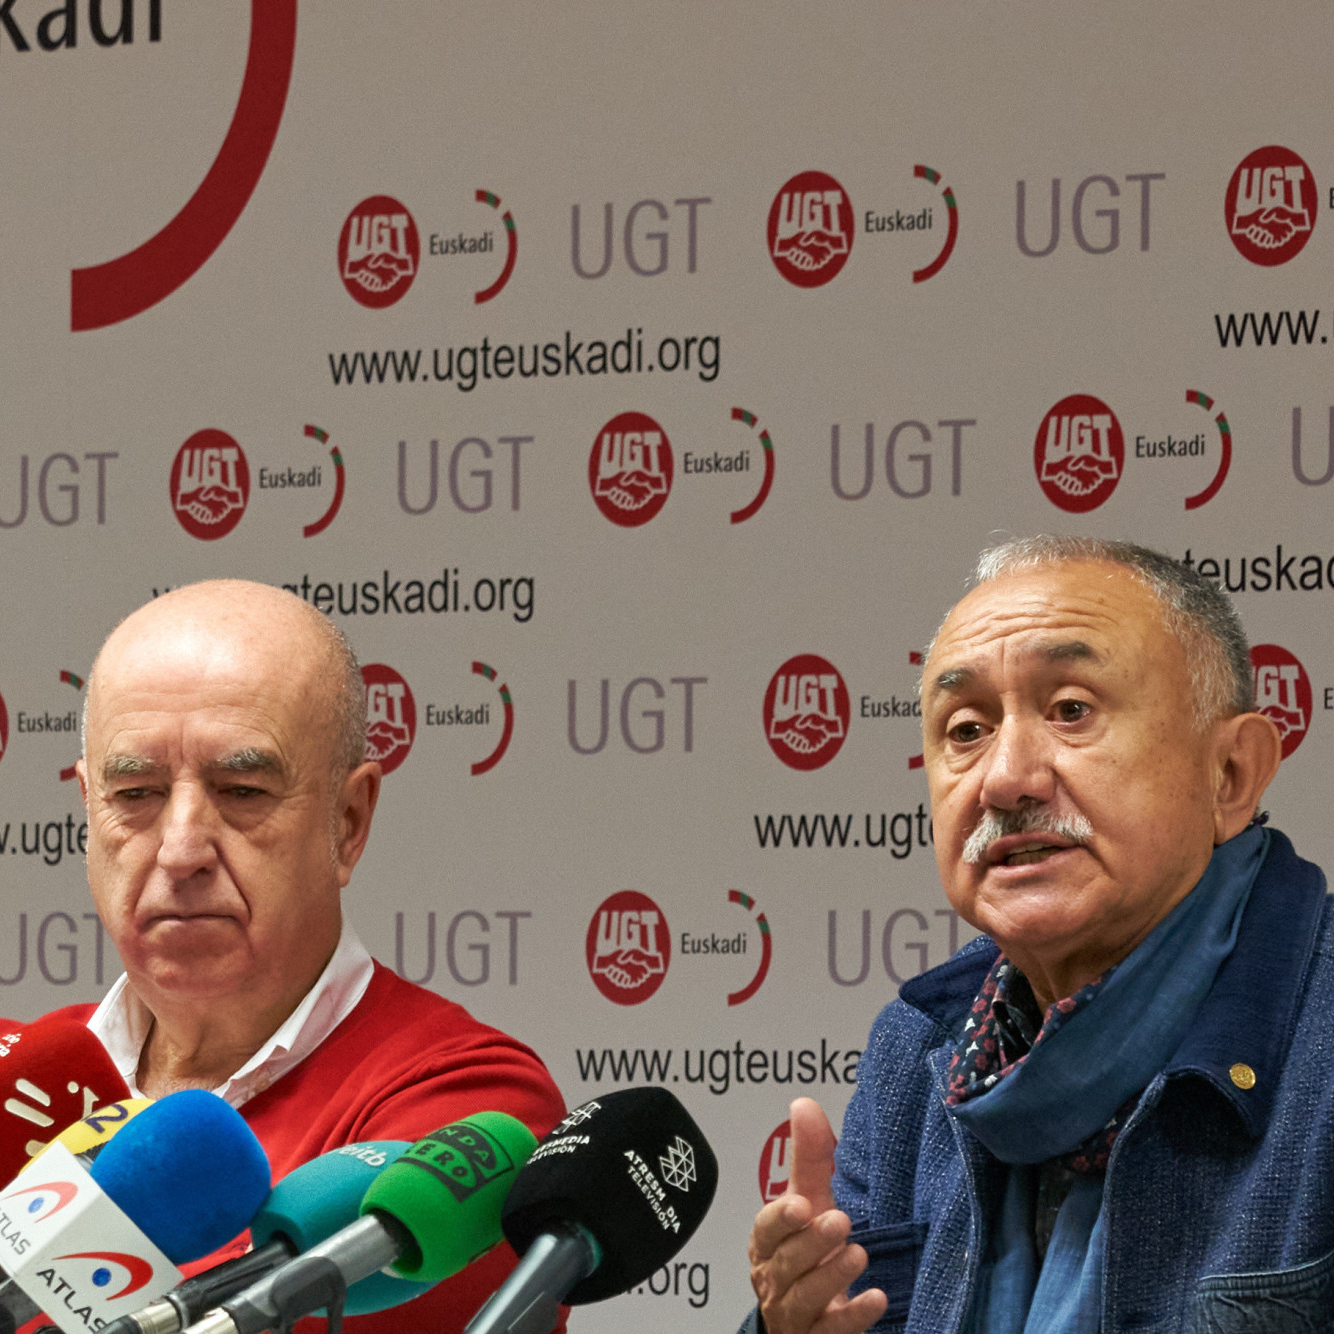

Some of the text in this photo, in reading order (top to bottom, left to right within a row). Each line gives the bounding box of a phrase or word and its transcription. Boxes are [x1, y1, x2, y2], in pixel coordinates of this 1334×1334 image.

[1239, 165, 1306, 210] UGT
[349, 213, 494, 257] UGT Euskadi
[783, 190, 934, 234] UGT Euskadi
[1014, 172, 1166, 259] UGT
[570, 196, 712, 281] UGT
[328, 328, 722, 392] www.ugteuskadi.org
[602, 430, 751, 476] UGT Euskadi
[829, 418, 977, 501] UGT
[1046, 414, 1206, 460] UGT Euskadi
[183, 446, 322, 492] UGT Euskadi
[396, 435, 535, 516] UGT
[365, 682, 490, 727] GT Euskadi
[773, 674, 838, 717] UGT
[1254, 664, 1300, 713] GT
[17, 711, 78, 734] Euskadi
[566, 676, 708, 756] UGT
[393, 910, 533, 988] UGT
[596, 909, 747, 957] UGT Euskadi
[406, 1142, 469, 1178] ERO
[438, 1126, 491, 1164] NDA
[35, 1267, 109, 1334] ATLAS
